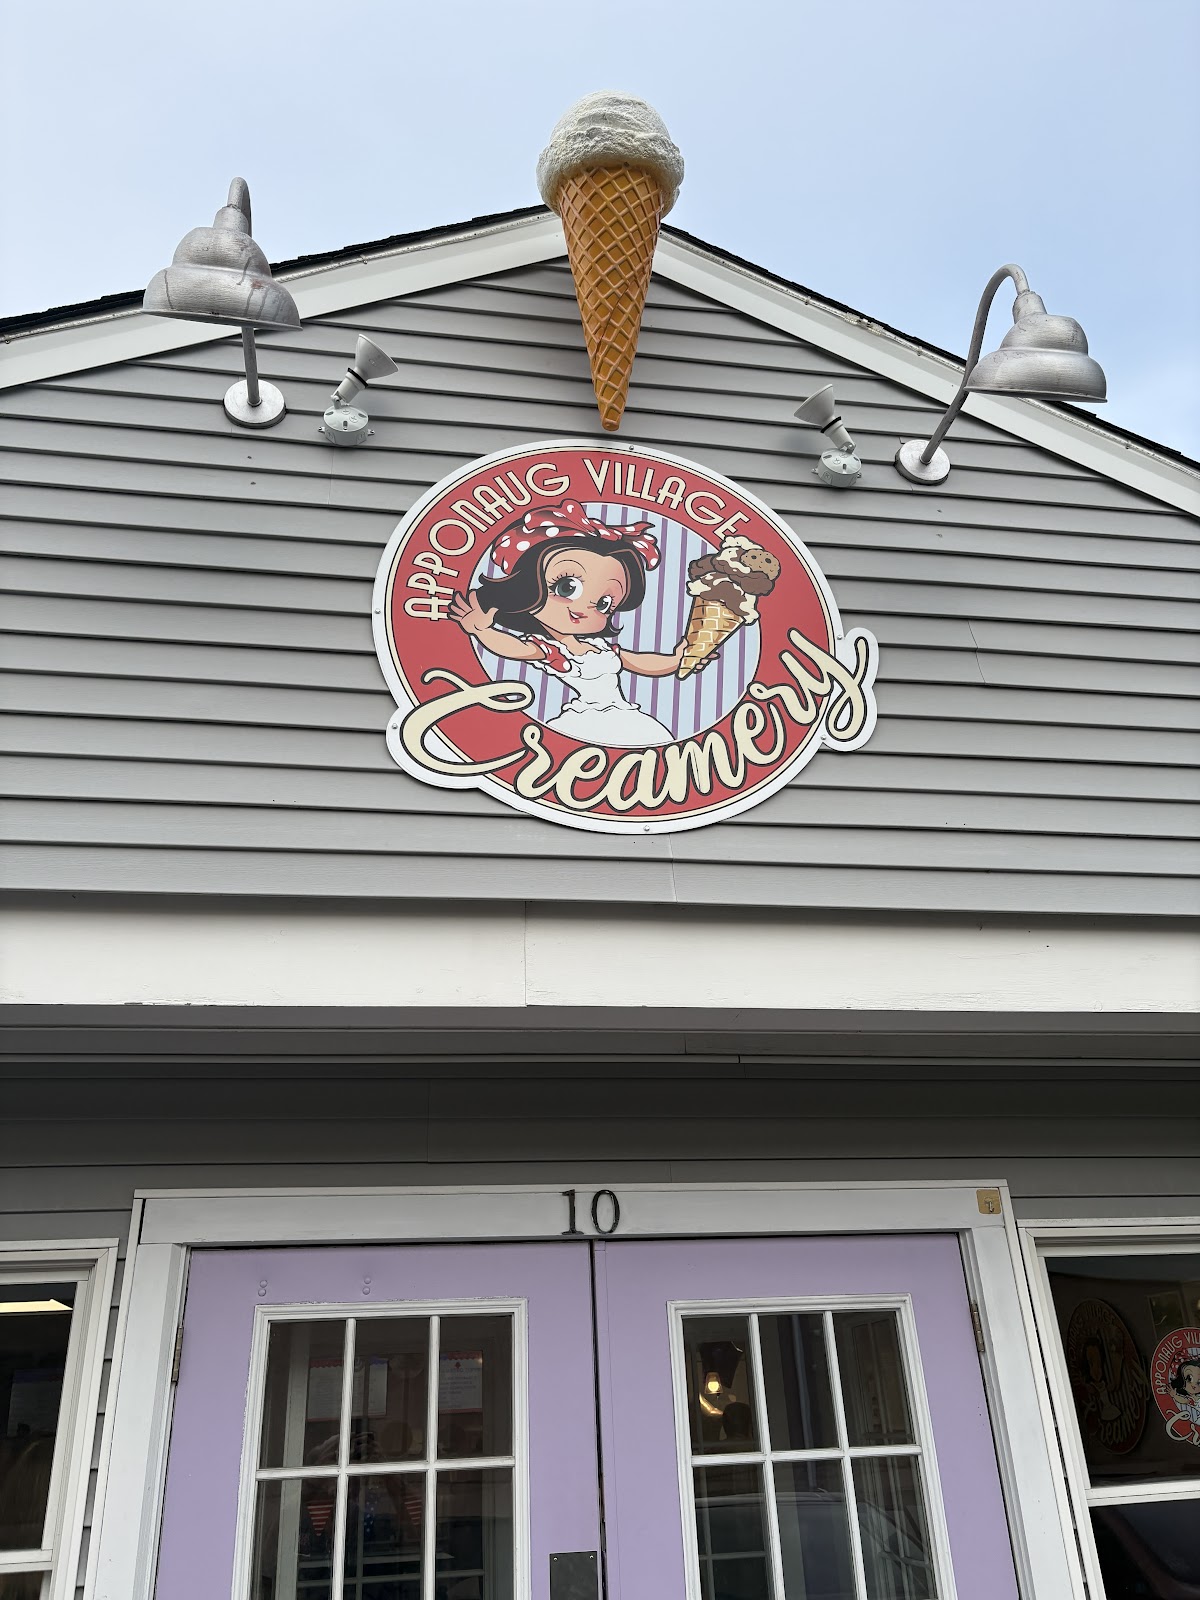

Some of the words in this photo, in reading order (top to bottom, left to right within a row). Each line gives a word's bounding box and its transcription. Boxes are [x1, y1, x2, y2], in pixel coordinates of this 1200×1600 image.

[403, 462, 571, 621] APPONAUG
[581, 457, 752, 541] VILLAGE
[400, 627, 869, 812] Creamery
[561, 1189, 620, 1235] 10
[1154, 1335, 1183, 1395] APPONAUG
